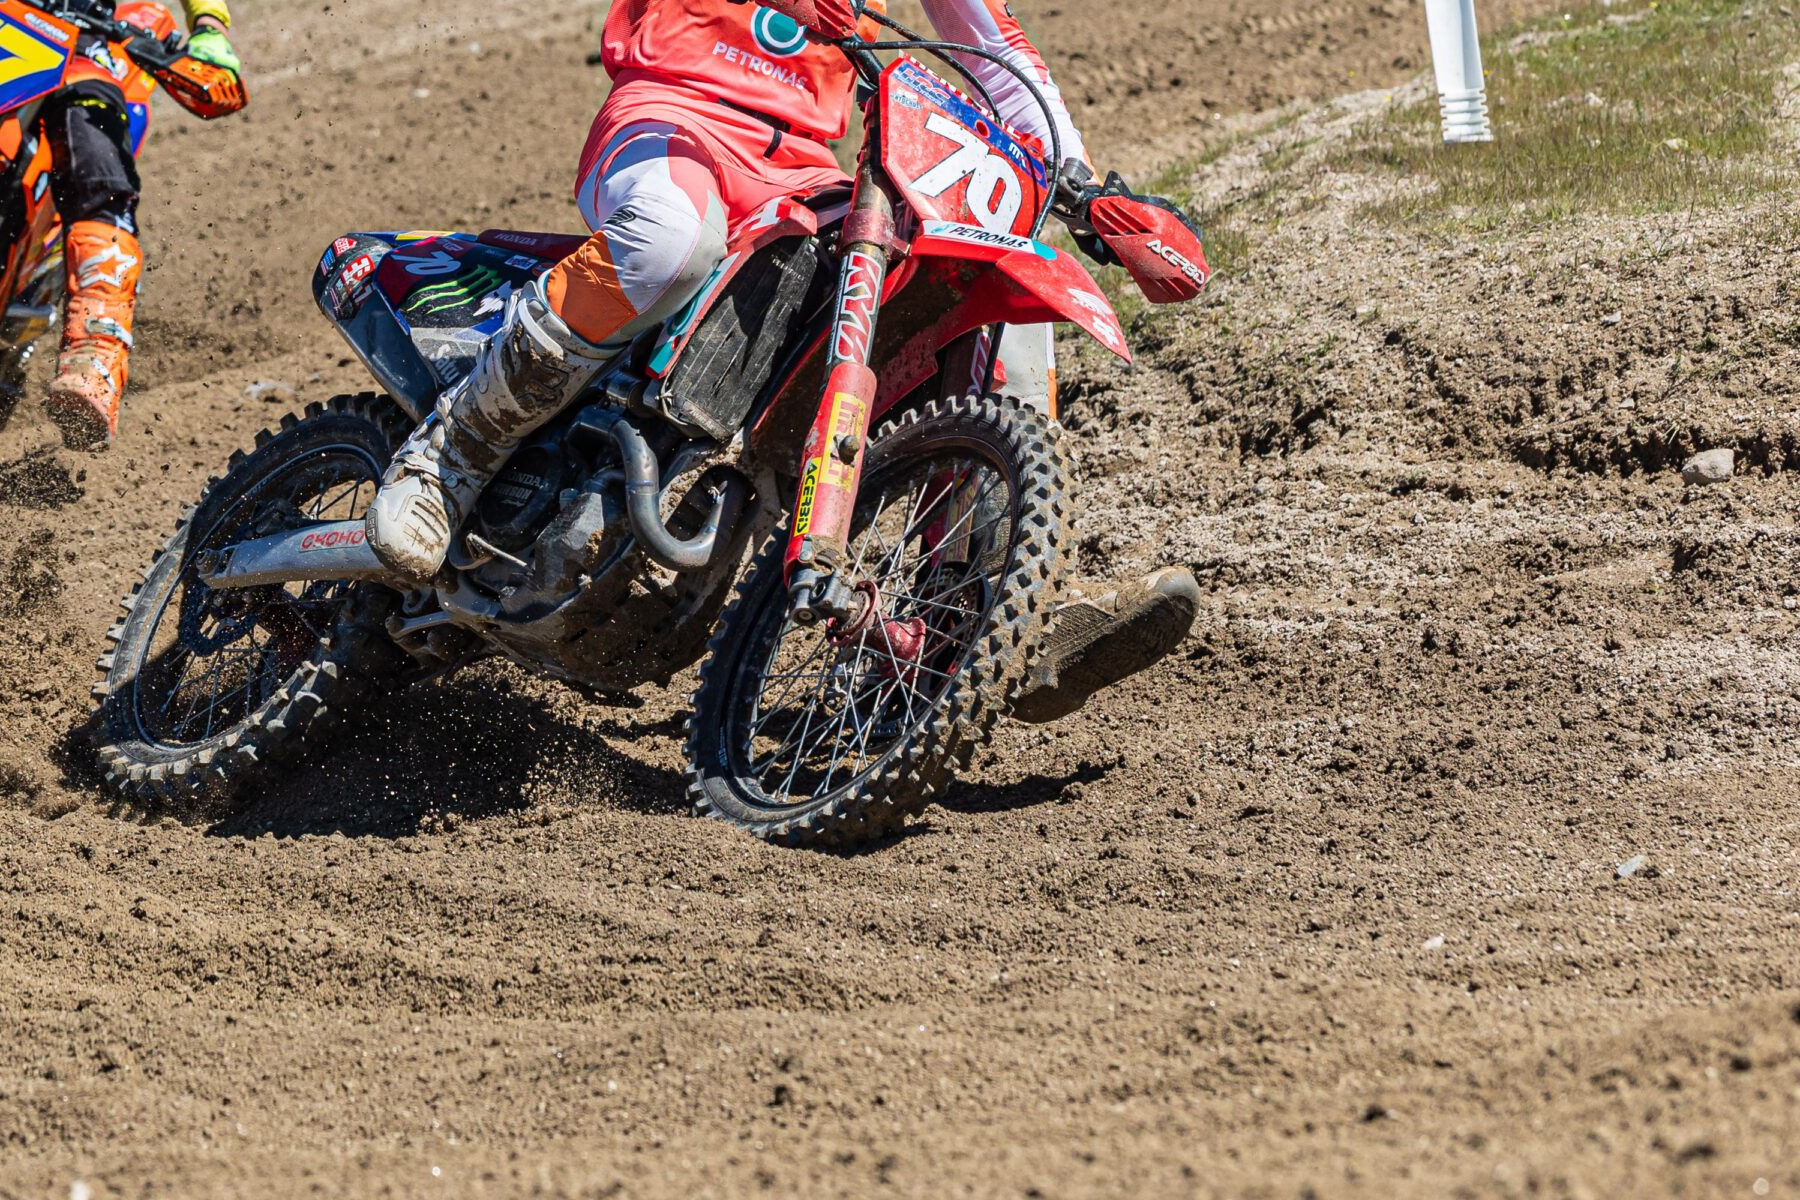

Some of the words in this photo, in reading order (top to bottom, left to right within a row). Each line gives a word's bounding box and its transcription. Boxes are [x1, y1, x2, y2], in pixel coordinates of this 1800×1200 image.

[712, 41, 809, 90] PETRONAS
[907, 111, 1023, 233] 70
[494, 232, 538, 247] HONDA
[948, 222, 1029, 251] PETRONAS
[1144, 238, 1206, 286] ACERBIS
[835, 252, 882, 366] KYB
[794, 461, 818, 536] ACERBIS
[300, 528, 367, 551] CHOHO
